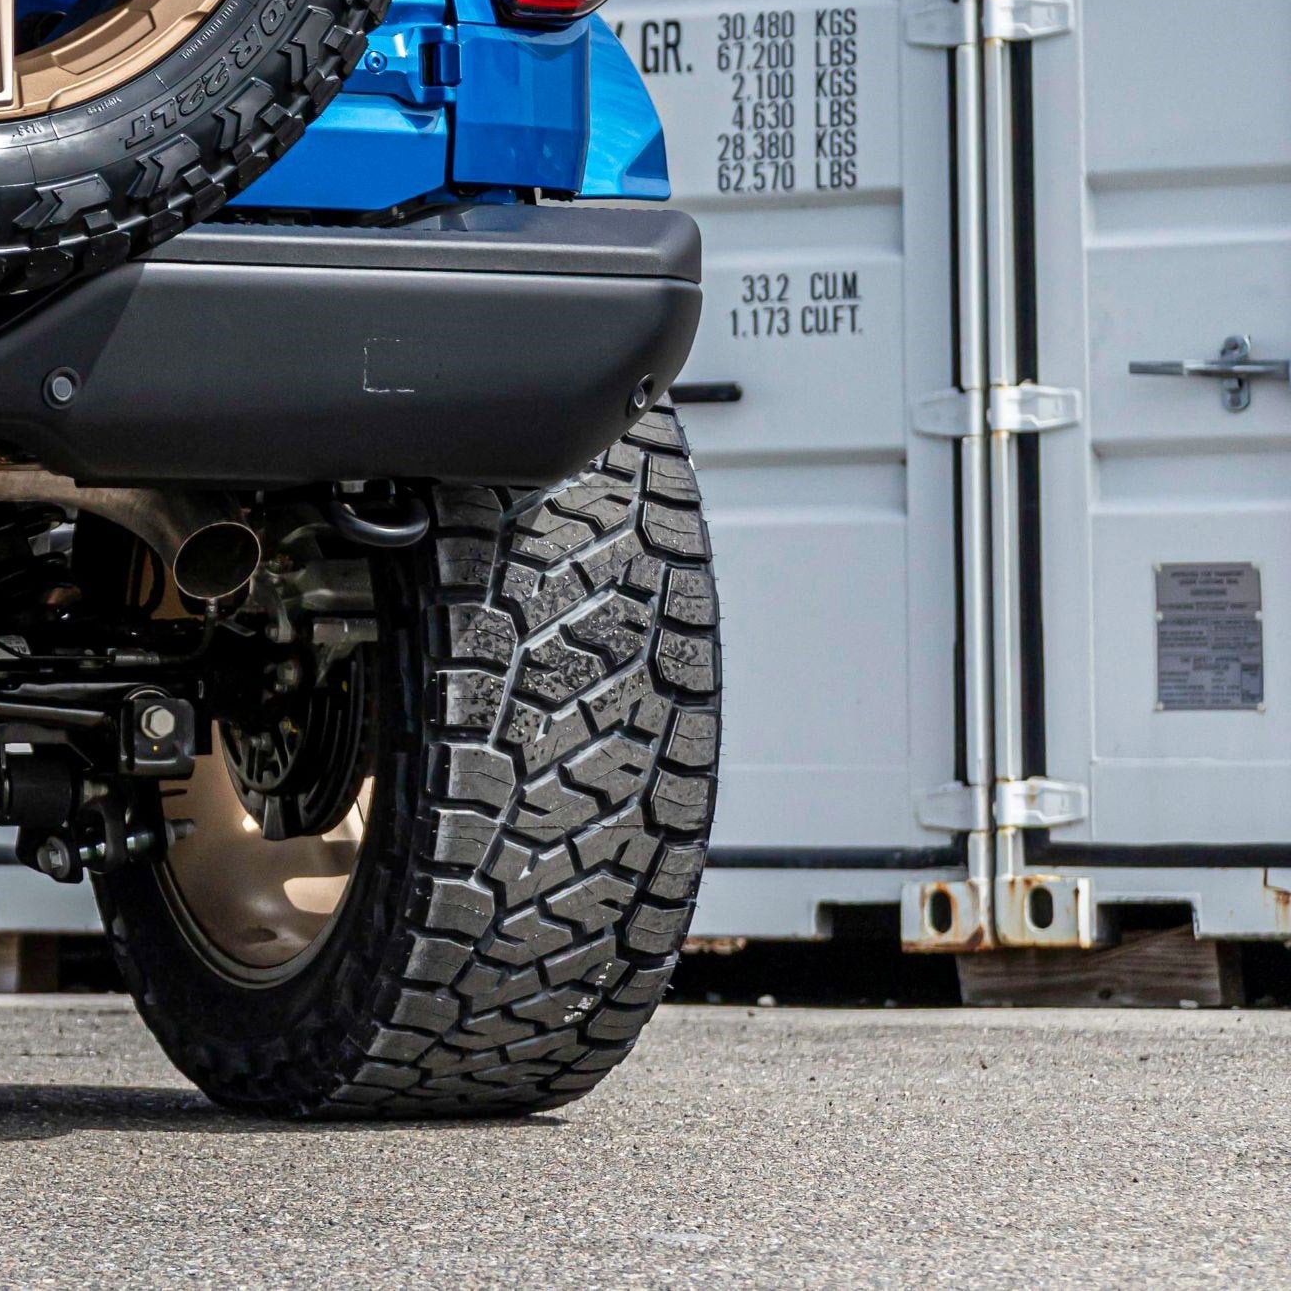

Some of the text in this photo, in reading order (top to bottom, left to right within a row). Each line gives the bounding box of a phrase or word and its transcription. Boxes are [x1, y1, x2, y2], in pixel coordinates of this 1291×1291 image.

[641, 18, 693, 74] GR.
[718, 11, 794, 41] 30.480
[815, 8, 857, 36] KGS
[718, 38, 857, 71] 67.200 LBS
[732, 68, 857, 101] 2.100 KGS
[732, 98, 857, 131] 4.630 LBS
[718, 128, 857, 162] 28.380 KGS
[718, 160, 857, 192] 62.570 LBS
[730, 306, 790, 338] 1.173
